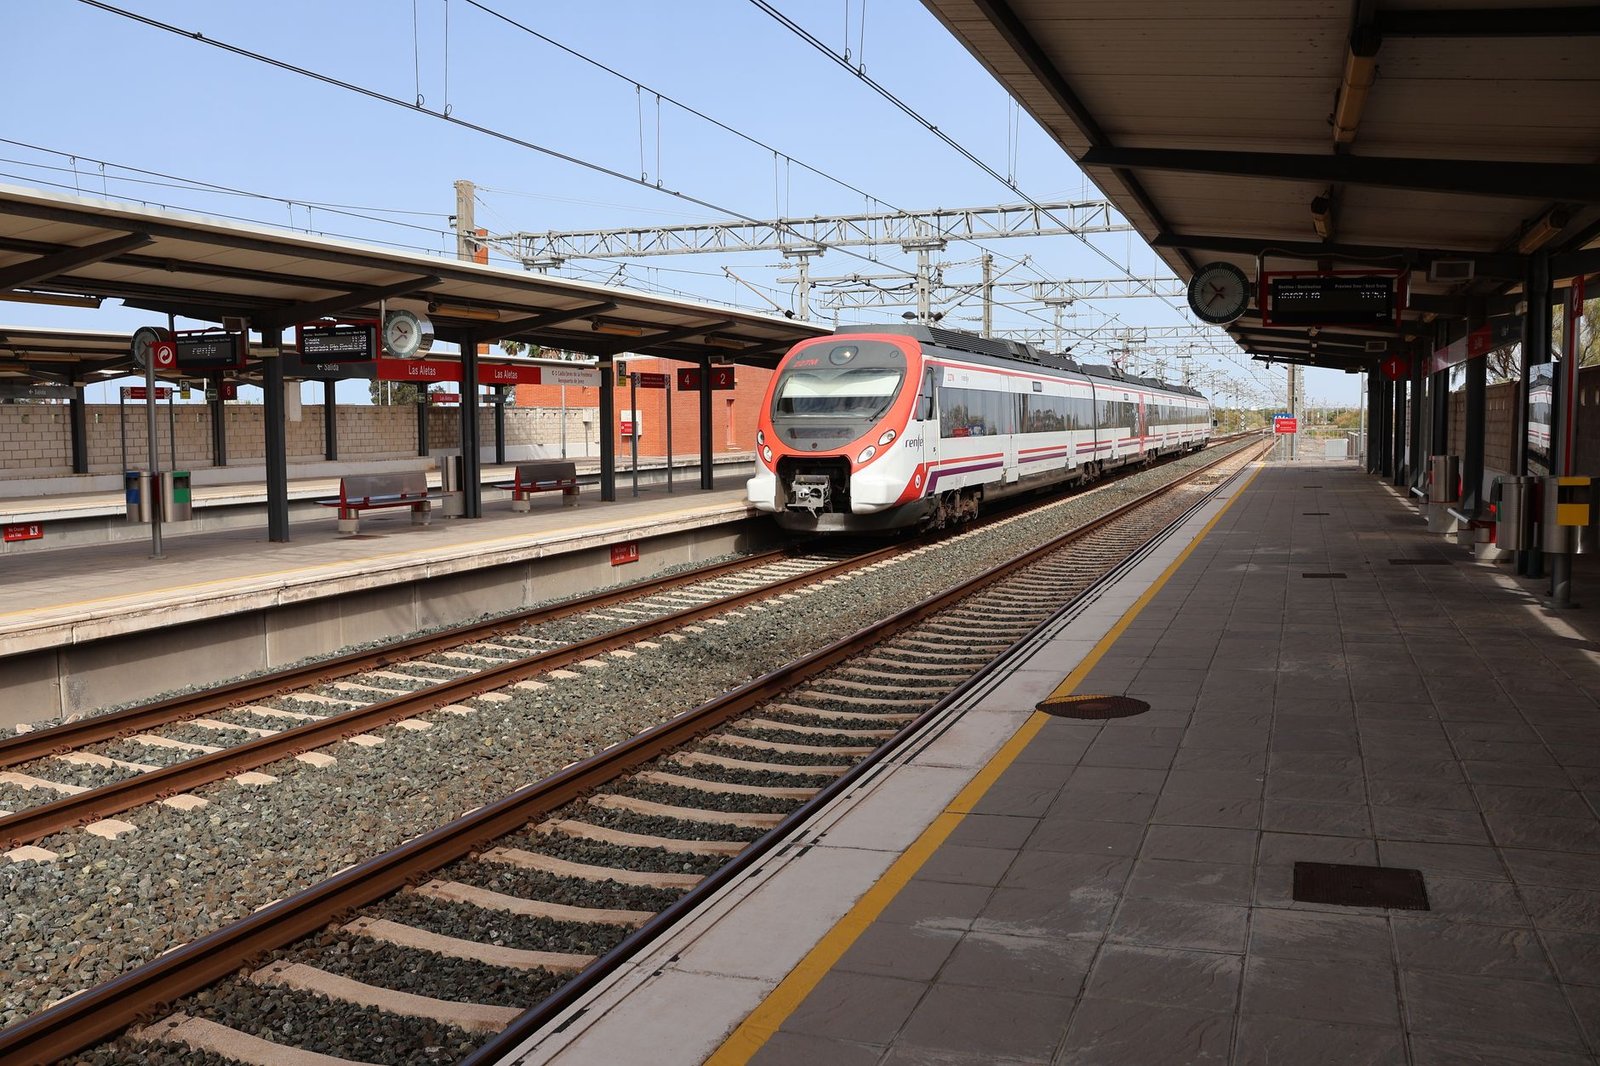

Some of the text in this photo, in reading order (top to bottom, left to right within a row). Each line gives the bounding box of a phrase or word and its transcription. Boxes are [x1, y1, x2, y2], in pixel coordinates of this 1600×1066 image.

[408, 364, 437, 376] Las Aletas
[494, 369, 518, 379] Las Aletas
[1390, 361, 1396, 375] 1
[684, 374, 691, 385] 4
[720, 373, 726, 385] 2
[905, 433, 924, 453] renfe
